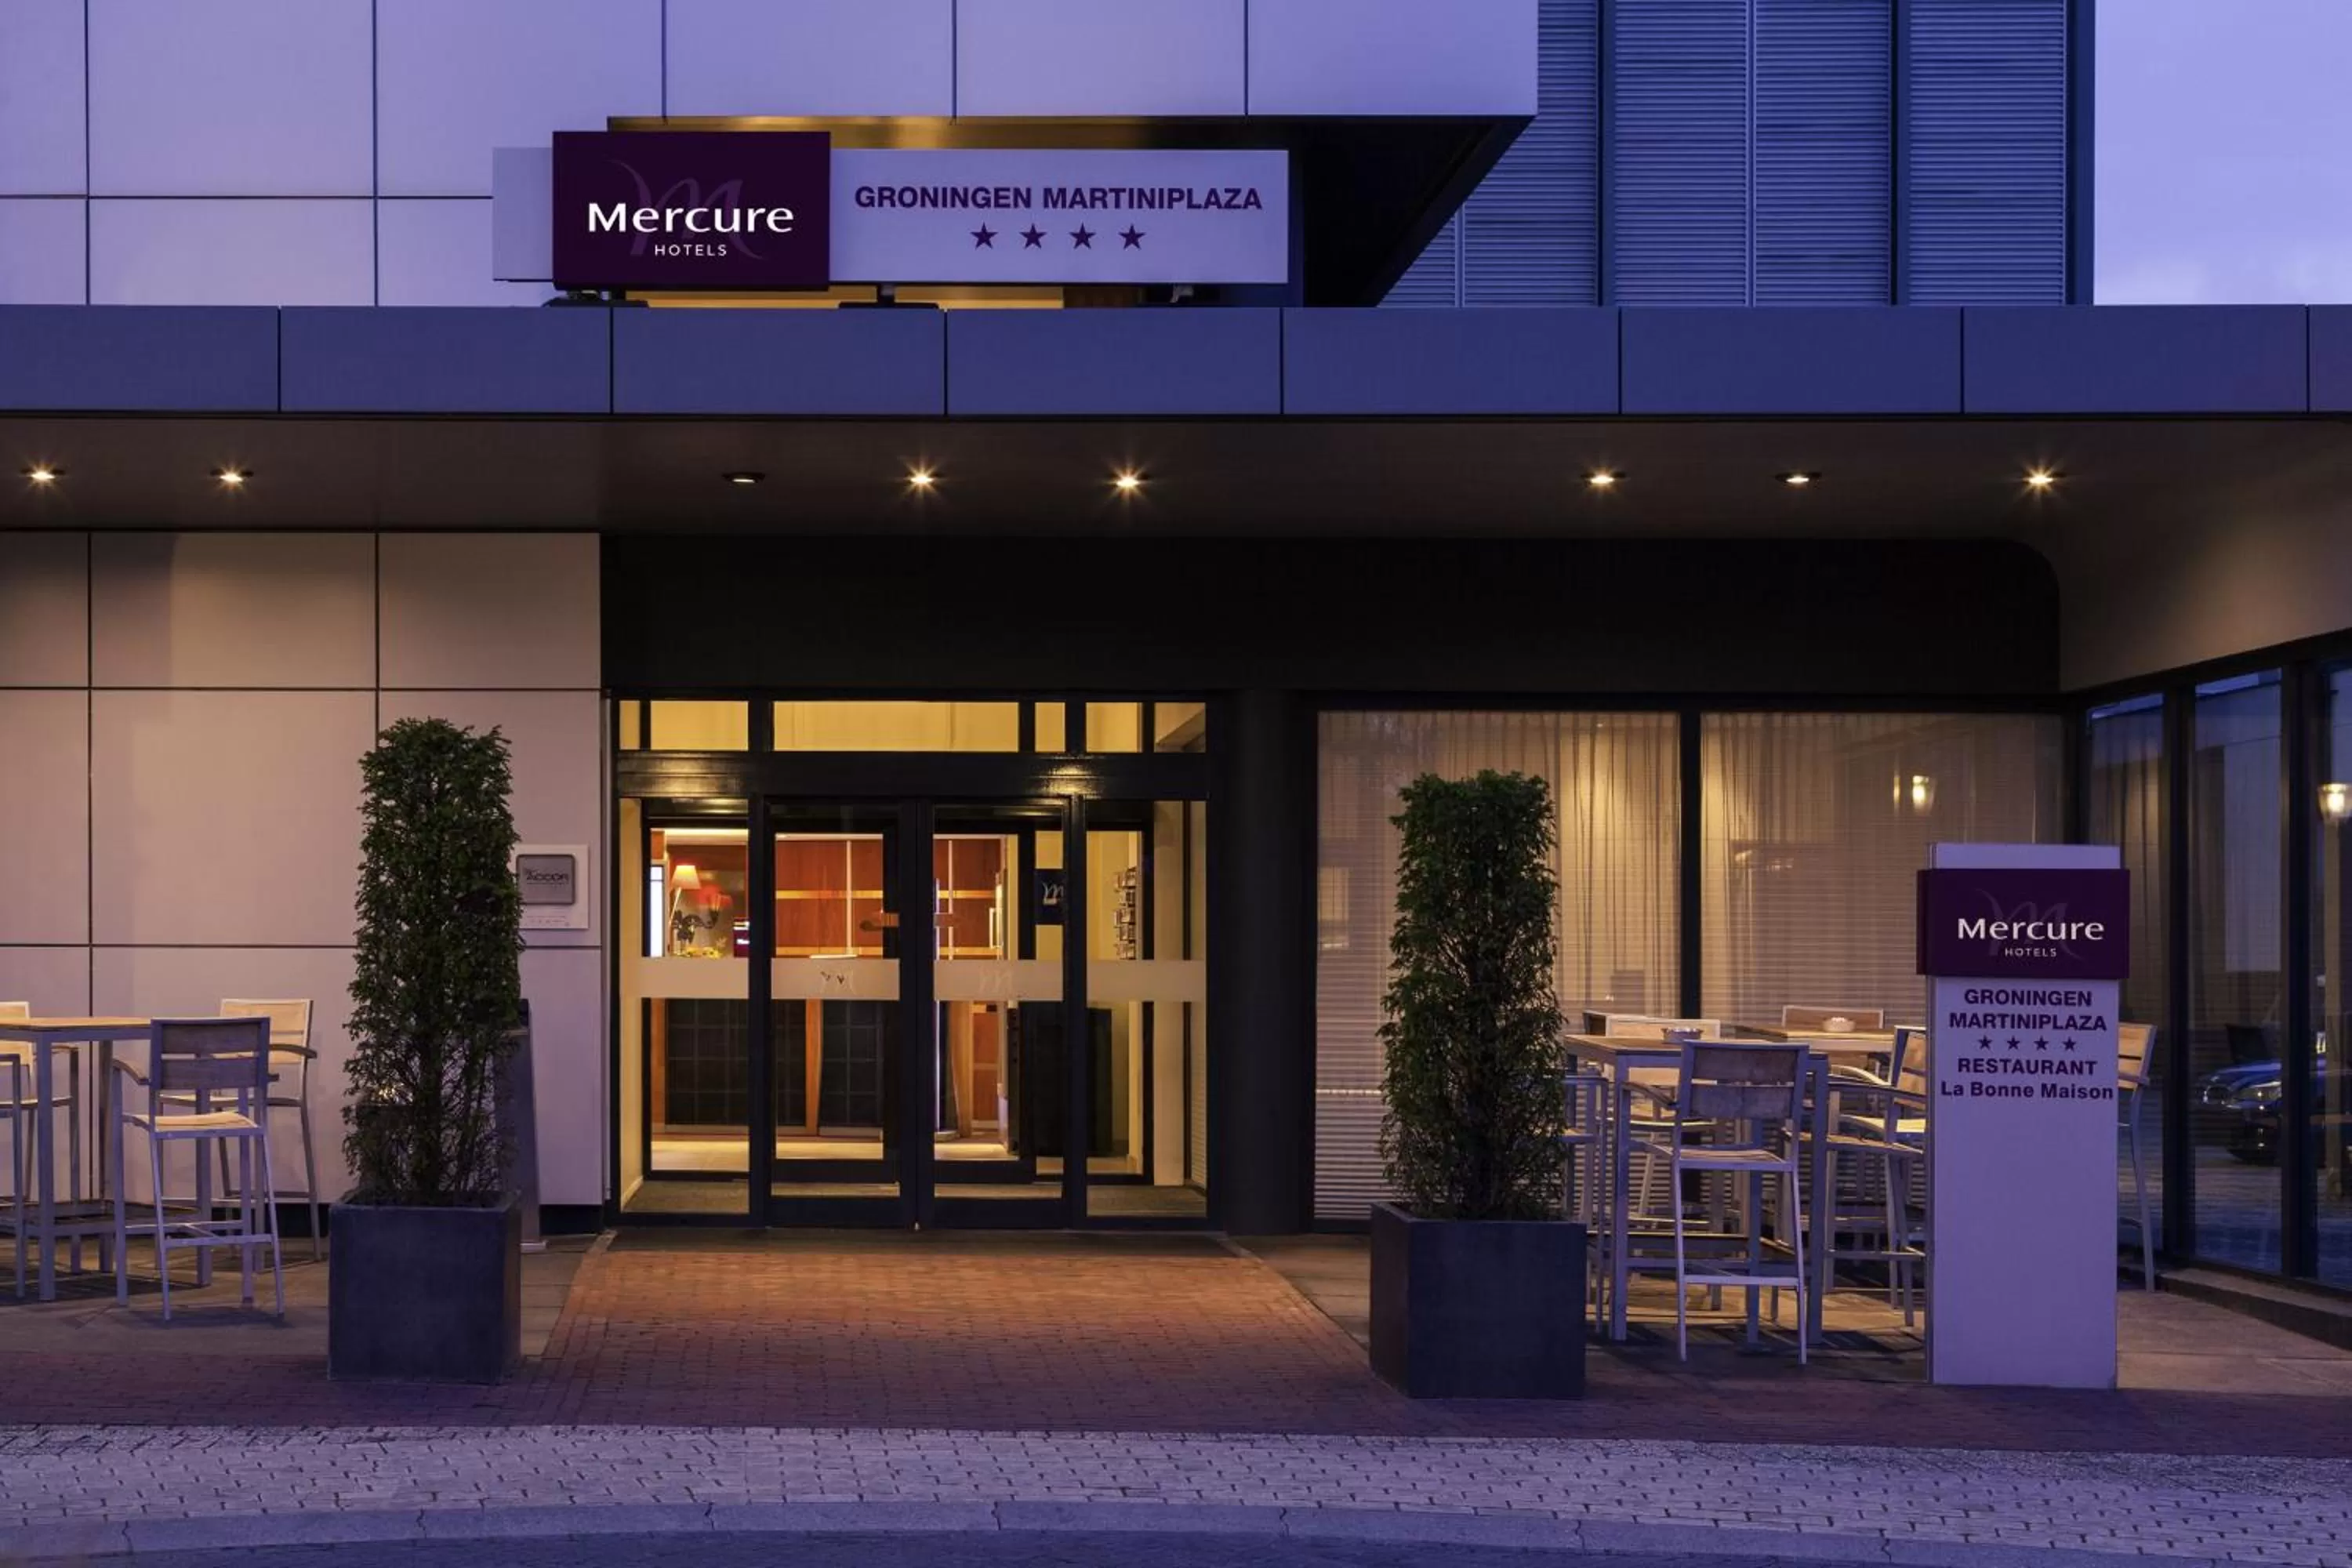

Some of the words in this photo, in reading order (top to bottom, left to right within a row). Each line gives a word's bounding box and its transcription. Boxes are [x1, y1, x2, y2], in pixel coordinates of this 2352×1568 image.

[855, 185, 1033, 210] GRONINGEN
[1042, 186, 1264, 212] MARTINIPLAZA
[588, 201, 795, 234] Mercure
[654, 244, 728, 257] HOTELS
[1957, 917, 2105, 941] Mercure
[2005, 947, 2057, 957] HOTELS
[1963, 989, 2092, 1007] GRONINGEN
[1948, 1012, 2107, 1032] MARTINIPLAZA
[1957, 1058, 2099, 1076] RESTAURANT
[1941, 1080, 1965, 1098] La
[1970, 1081, 2035, 1098] Bonne
[2040, 1083, 2114, 1102] Maison
